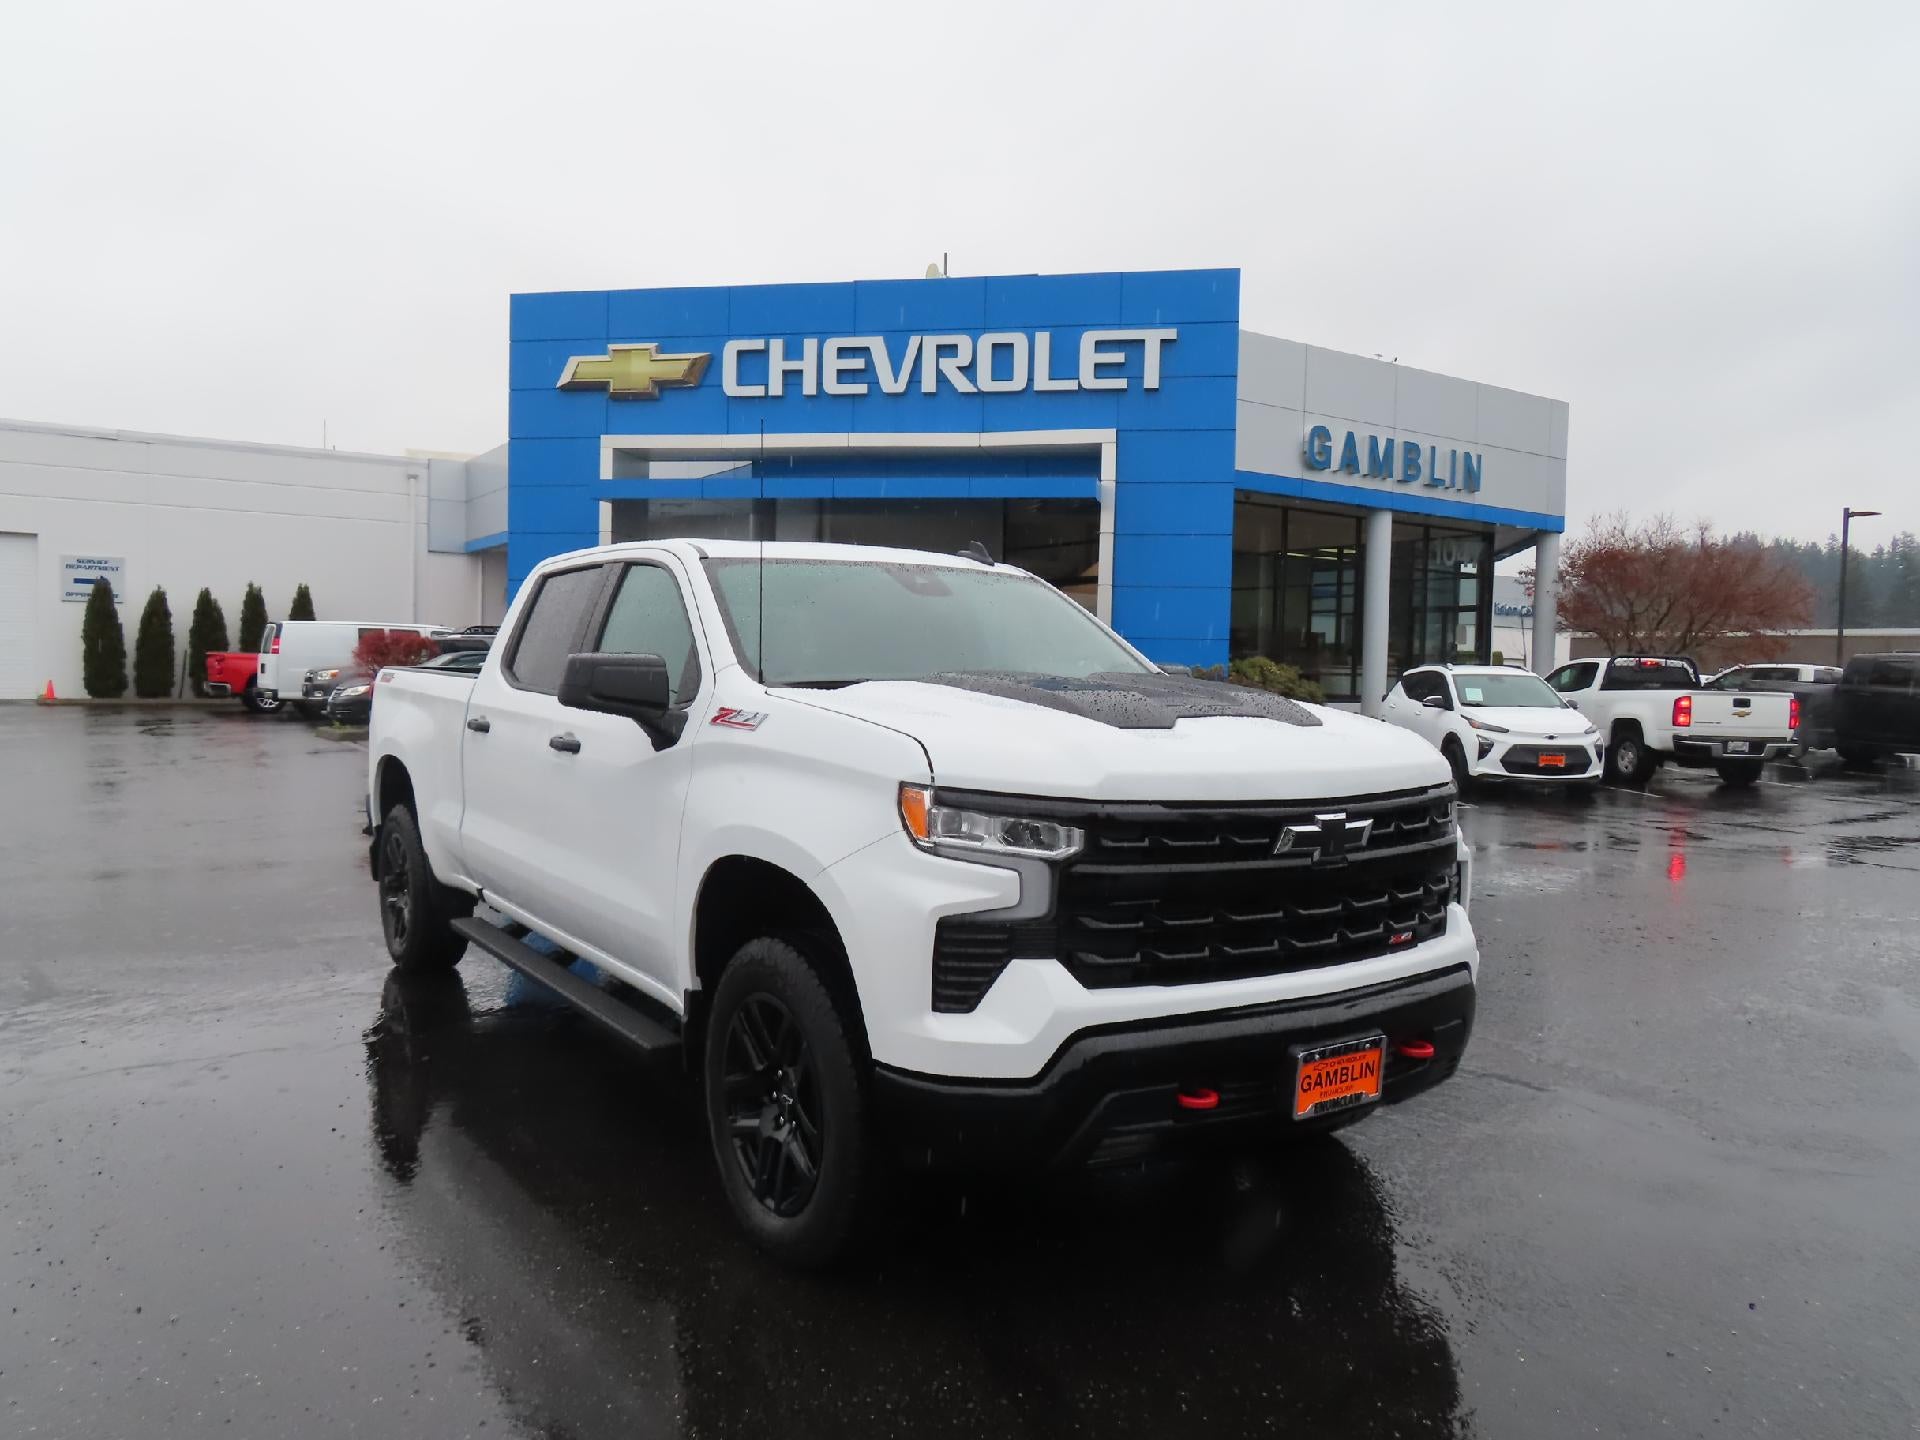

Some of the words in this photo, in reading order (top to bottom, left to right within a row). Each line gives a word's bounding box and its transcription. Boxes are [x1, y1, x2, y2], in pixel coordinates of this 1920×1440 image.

[722, 328, 1177, 397] CHEVROLET
[1306, 425, 1482, 493] GAMBLIN
[1300, 1060, 1376, 1094] GAMBLIN
